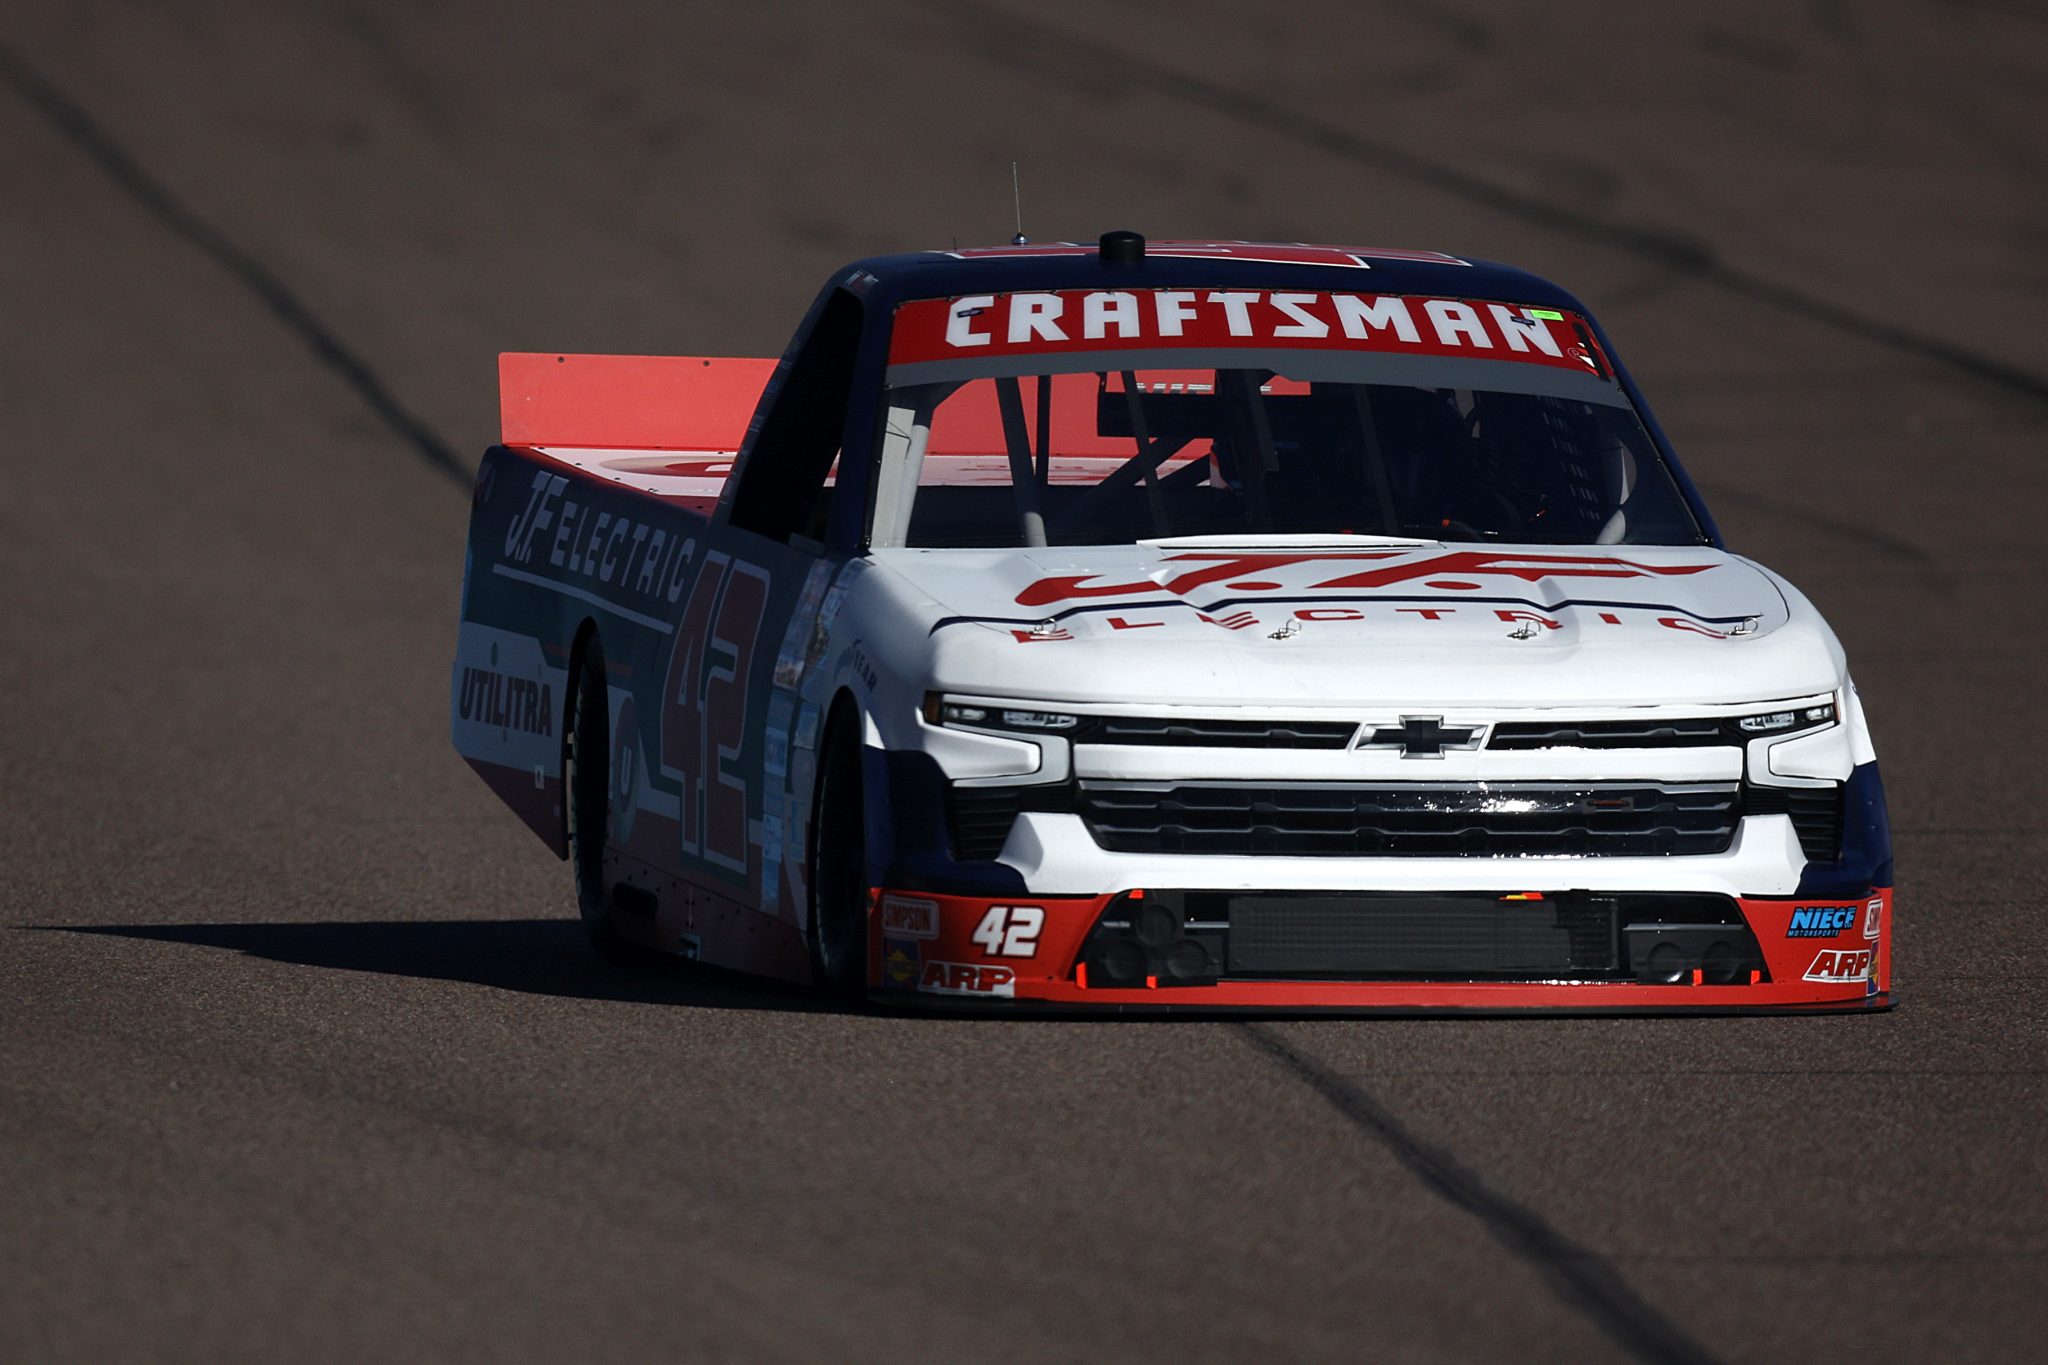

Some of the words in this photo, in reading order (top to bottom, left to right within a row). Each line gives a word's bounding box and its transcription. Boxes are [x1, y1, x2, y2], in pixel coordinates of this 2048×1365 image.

[944, 290, 1564, 358] CRAFTSMAN
[550, 501, 695, 603] ELECTRIC
[1011, 608, 1728, 642] ELECTRIC
[459, 667, 551, 737] UTILITRA
[659, 548, 770, 875] 42
[885, 902, 931, 932] SIMPSON
[971, 905, 1045, 958] 42
[1787, 929, 1840, 937] MOTORSPORTS
[920, 961, 1014, 991] ARP
[1807, 952, 1870, 977] ARP
